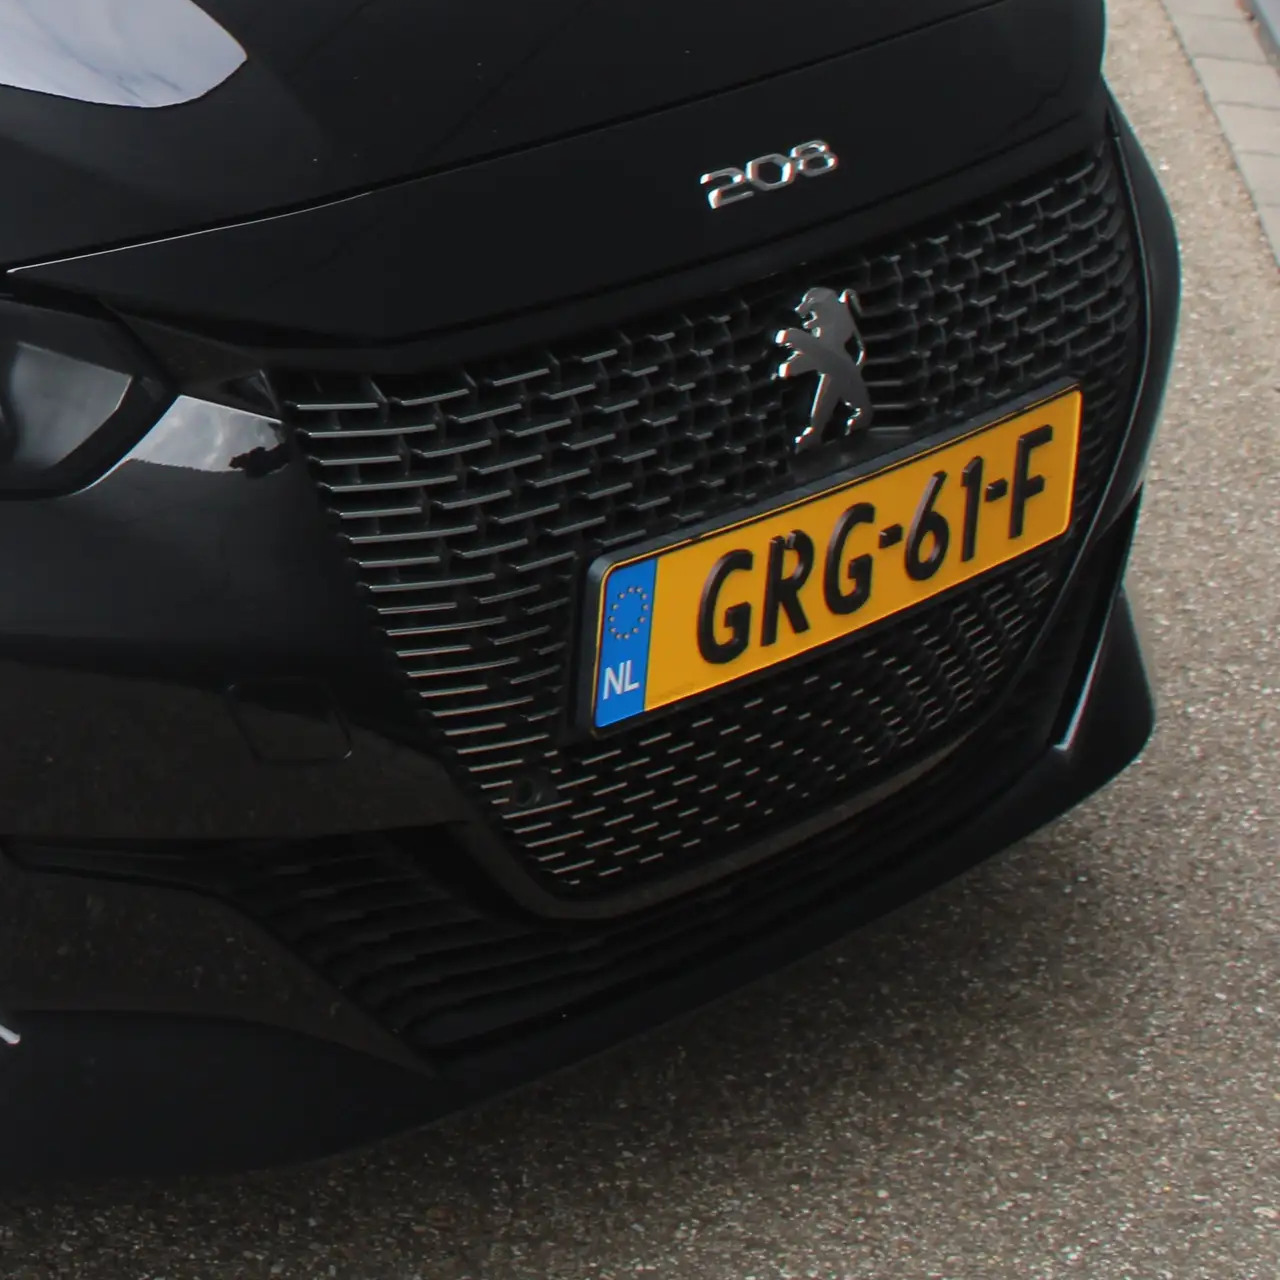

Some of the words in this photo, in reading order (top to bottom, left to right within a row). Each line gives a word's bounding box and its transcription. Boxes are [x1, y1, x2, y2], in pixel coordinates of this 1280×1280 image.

[700, 138, 838, 210] 208
[696, 423, 1054, 666] GRG-61-F
[602, 659, 640, 701] NL
